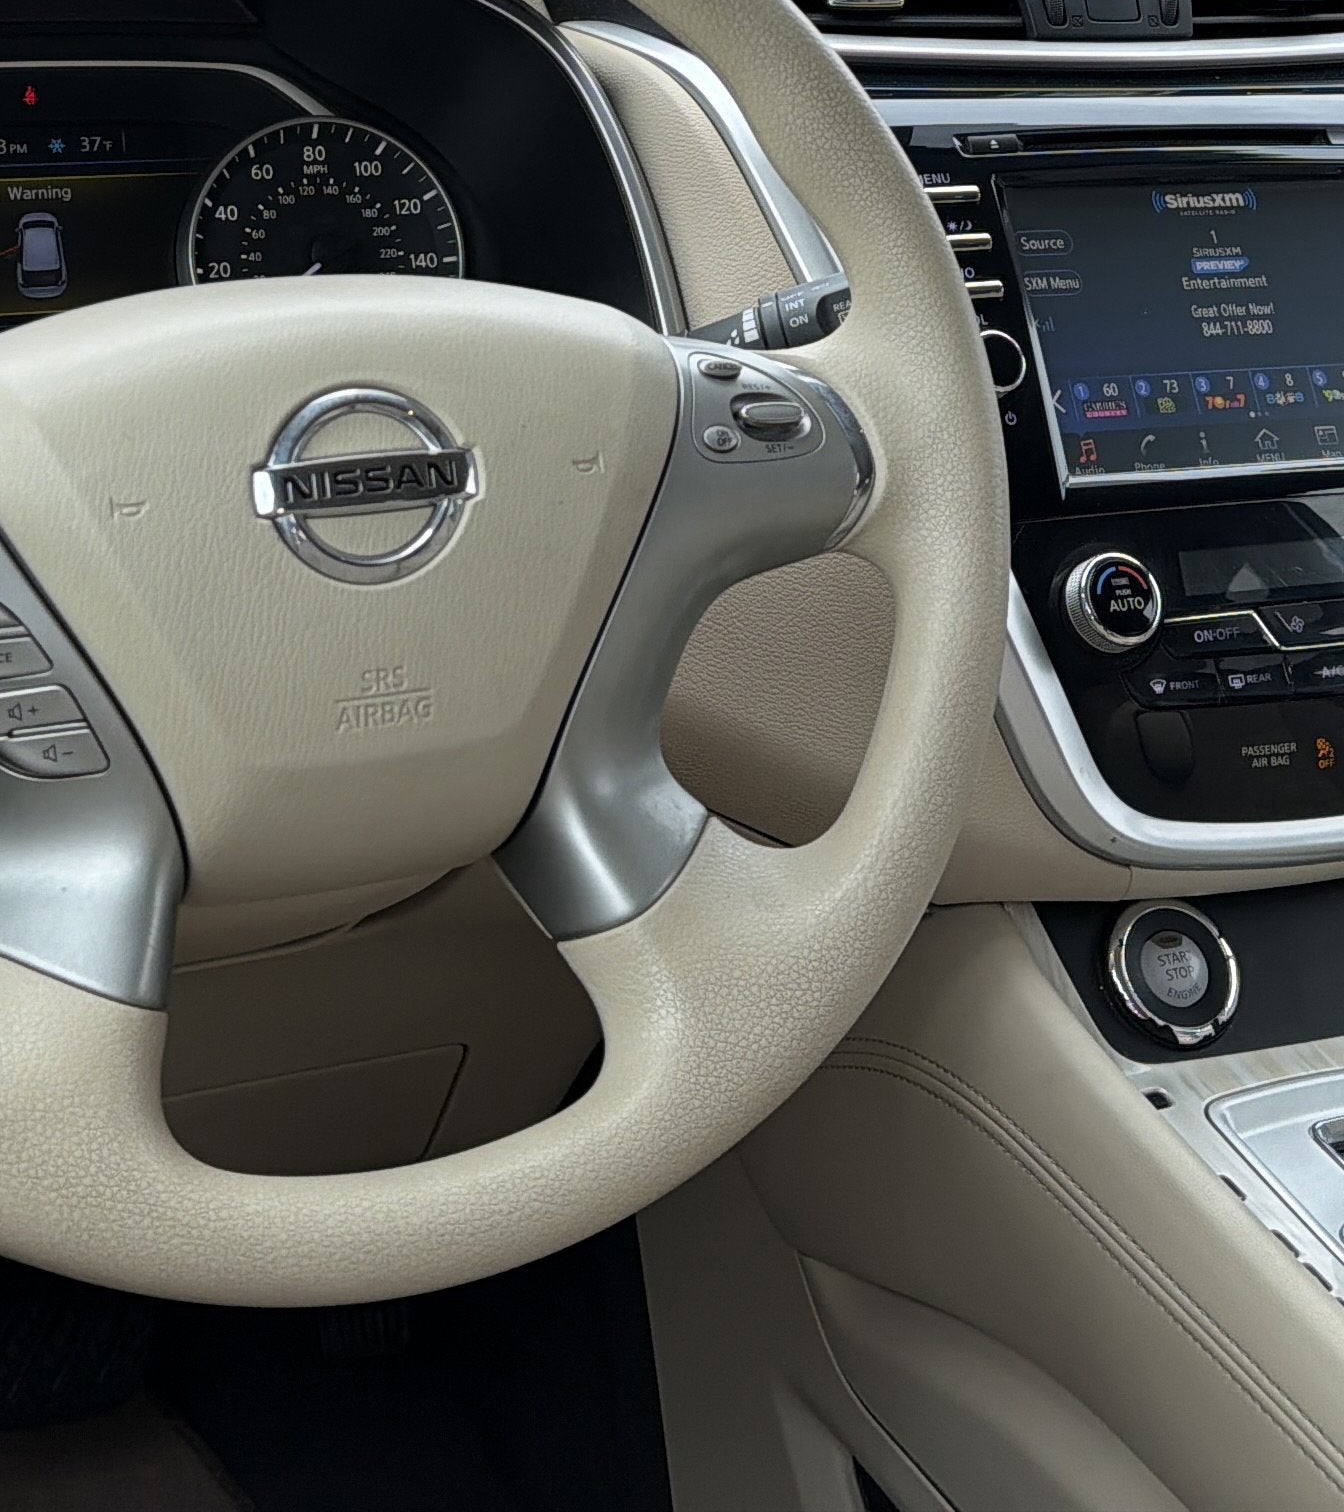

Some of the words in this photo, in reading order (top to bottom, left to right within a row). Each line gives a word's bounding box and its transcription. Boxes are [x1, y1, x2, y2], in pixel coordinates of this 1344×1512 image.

[303, 146, 326, 161] 80
[251, 164, 273, 180] 60
[303, 164, 328, 174] MPH
[354, 161, 382, 176] 100
[8, 186, 72, 202] Warning
[299, 186, 315, 195] 120
[322, 186, 339, 195] 140
[278, 195, 295, 205] 100
[345, 194, 362, 204] 160
[215, 205, 238, 221] 40
[361, 208, 378, 218] 180
[393, 198, 421, 215] 120
[263, 209, 277, 220] 80
[252, 229, 265, 239] 60
[372, 226, 391, 236] 200
[1209, 230, 1217, 244] 1
[1020, 237, 1065, 250] Source
[248, 252, 262, 262] 40
[379, 249, 398, 258] 220
[1192, 246, 1241, 257] SIRIUSXM
[409, 253, 438, 269] 140
[208, 262, 231, 278] 20
[1024, 277, 1048, 290] SXM
[1050, 276, 1080, 289] Menu
[1182, 276, 1268, 290] Entertainment
[785, 299, 805, 312] INT
[833, 300, 852, 312] REA
[1191, 304, 1217, 318] Great
[1221, 303, 1246, 316] Offer
[1249, 302, 1275, 316] Now!
[789, 313, 809, 328] ON
[1201, 319, 1273, 336] 844-711-8800
[1103, 383, 1118, 396] 60
[1163, 380, 1179, 393] 73
[1226, 377, 1233, 390] 7
[1285, 373, 1294, 386] 8
[283, 460, 458, 504] NISSAN
[1110, 597, 1145, 613] AUTO
[1246, 672, 1272, 684] REAR
[1322, 665, 1344, 678] A/C
[361, 665, 407, 694] SRS
[1170, 679, 1199, 690] FRONT
[335, 695, 434, 734] AIRBAG
[1241, 743, 1296, 757] PASSENGER
[1252, 758, 1268, 768] AIR
[1271, 755, 1290, 766] BAG
[1318, 759, 1335, 769] OFF
[1166, 965, 1194, 981] STOP
